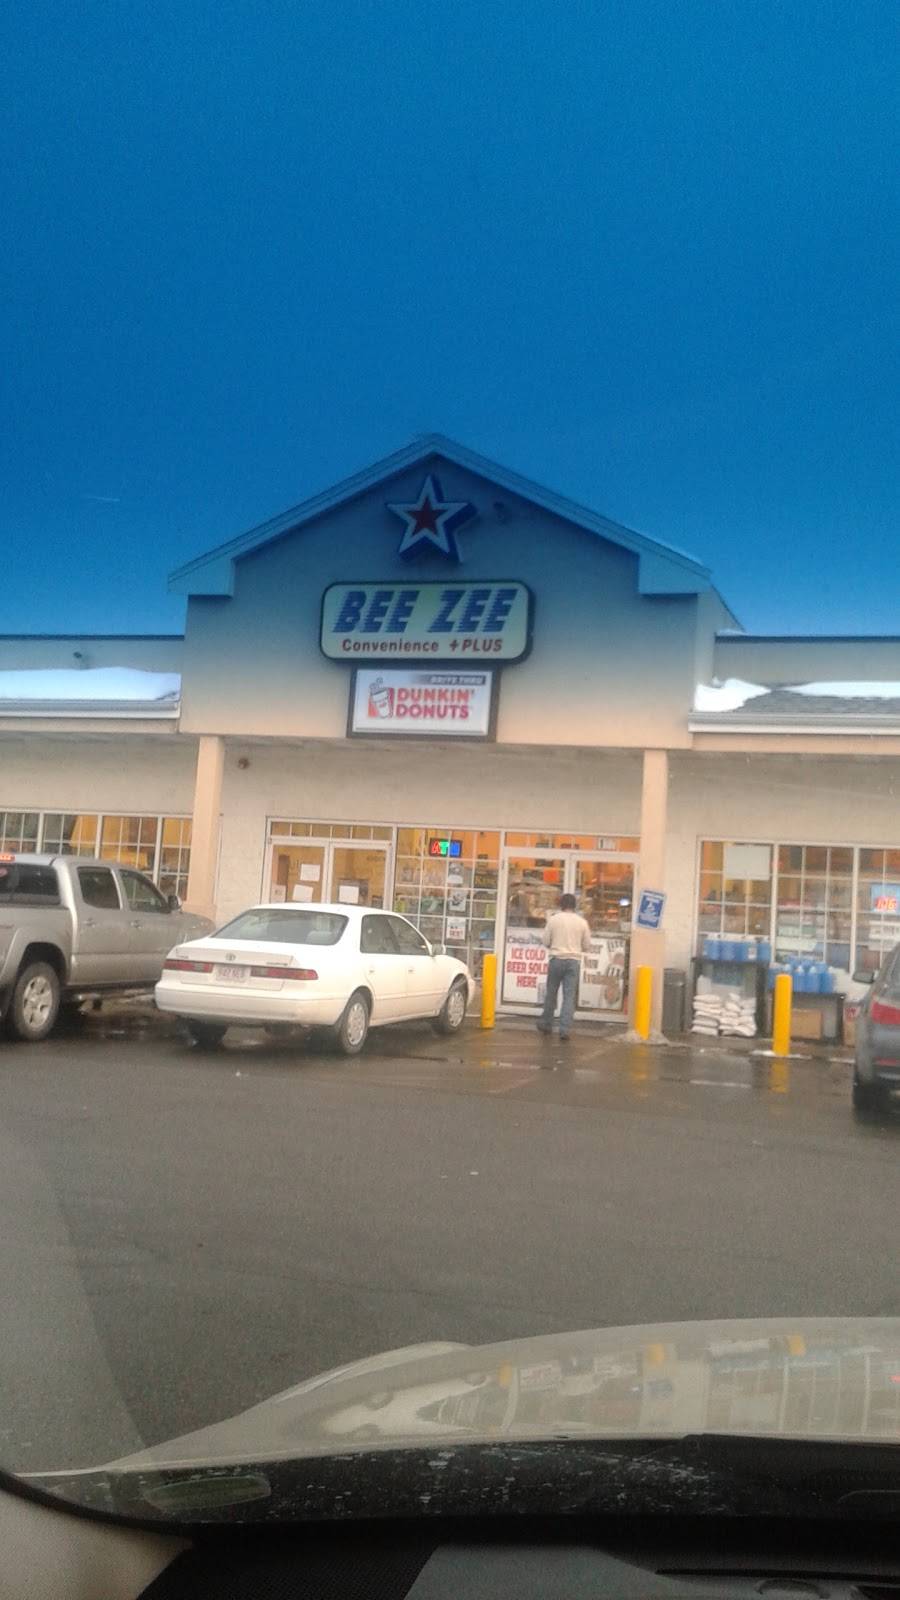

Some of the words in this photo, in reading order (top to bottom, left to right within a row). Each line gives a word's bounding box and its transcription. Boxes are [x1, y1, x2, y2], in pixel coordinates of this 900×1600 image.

[332, 590, 420, 633] BEE
[427, 589, 518, 633] ZEE
[342, 638, 439, 652] Convenience
[396, 703, 469, 719] DONUTS
[511, 947, 524, 960] ICE
[525, 948, 546, 961] COLD
[506, 961, 527, 974] BEER
[516, 975, 537, 989] HERE
